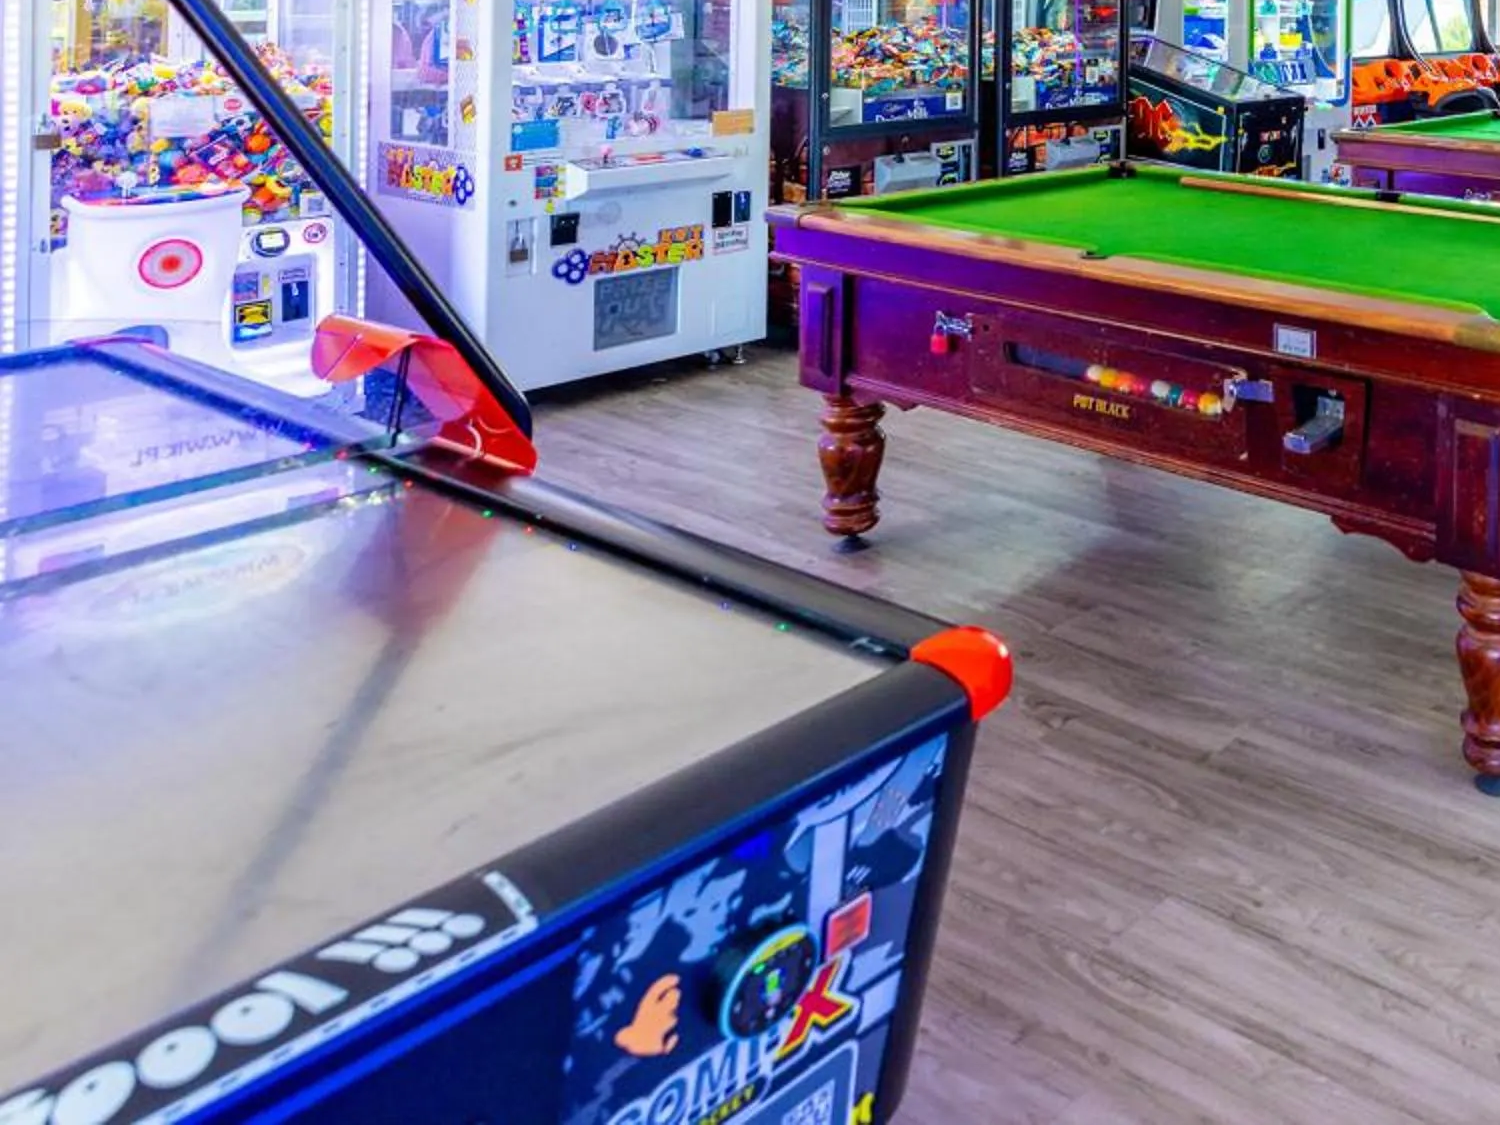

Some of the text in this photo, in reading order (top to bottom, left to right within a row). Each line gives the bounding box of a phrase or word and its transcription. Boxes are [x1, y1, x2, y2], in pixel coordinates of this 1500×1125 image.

[387, 160, 457, 198] MASTER
[587, 240, 704, 276] MASTER
[1073, 393, 1131, 420] POT BLACK
